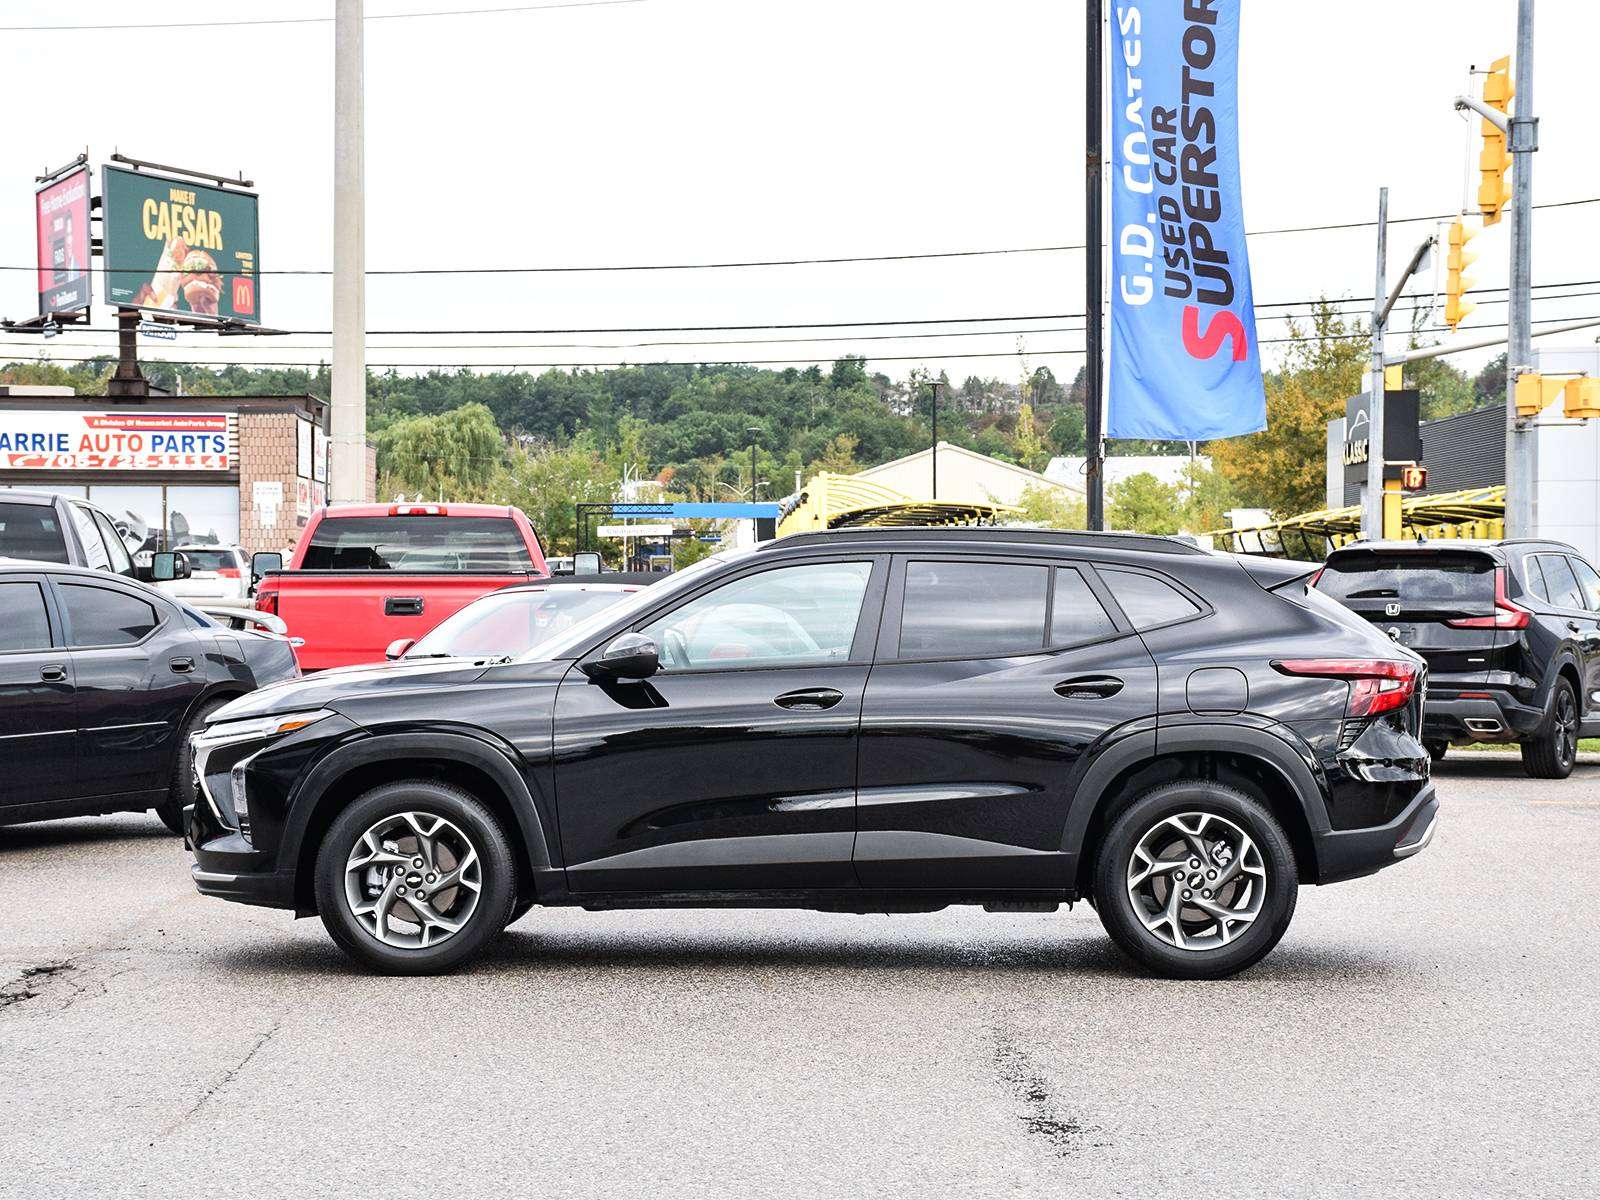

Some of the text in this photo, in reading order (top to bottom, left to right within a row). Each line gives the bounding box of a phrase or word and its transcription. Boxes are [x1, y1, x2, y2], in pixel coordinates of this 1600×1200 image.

[143, 198, 223, 250] CAESAR
[1151, 105, 1193, 299] USED CAR
[1120, 212, 1156, 305] G.D.
[0, 432, 226, 454] ARRIE AUTO PARTS
[100, 419, 125, 428] Division
[206, 419, 225, 430] Group
